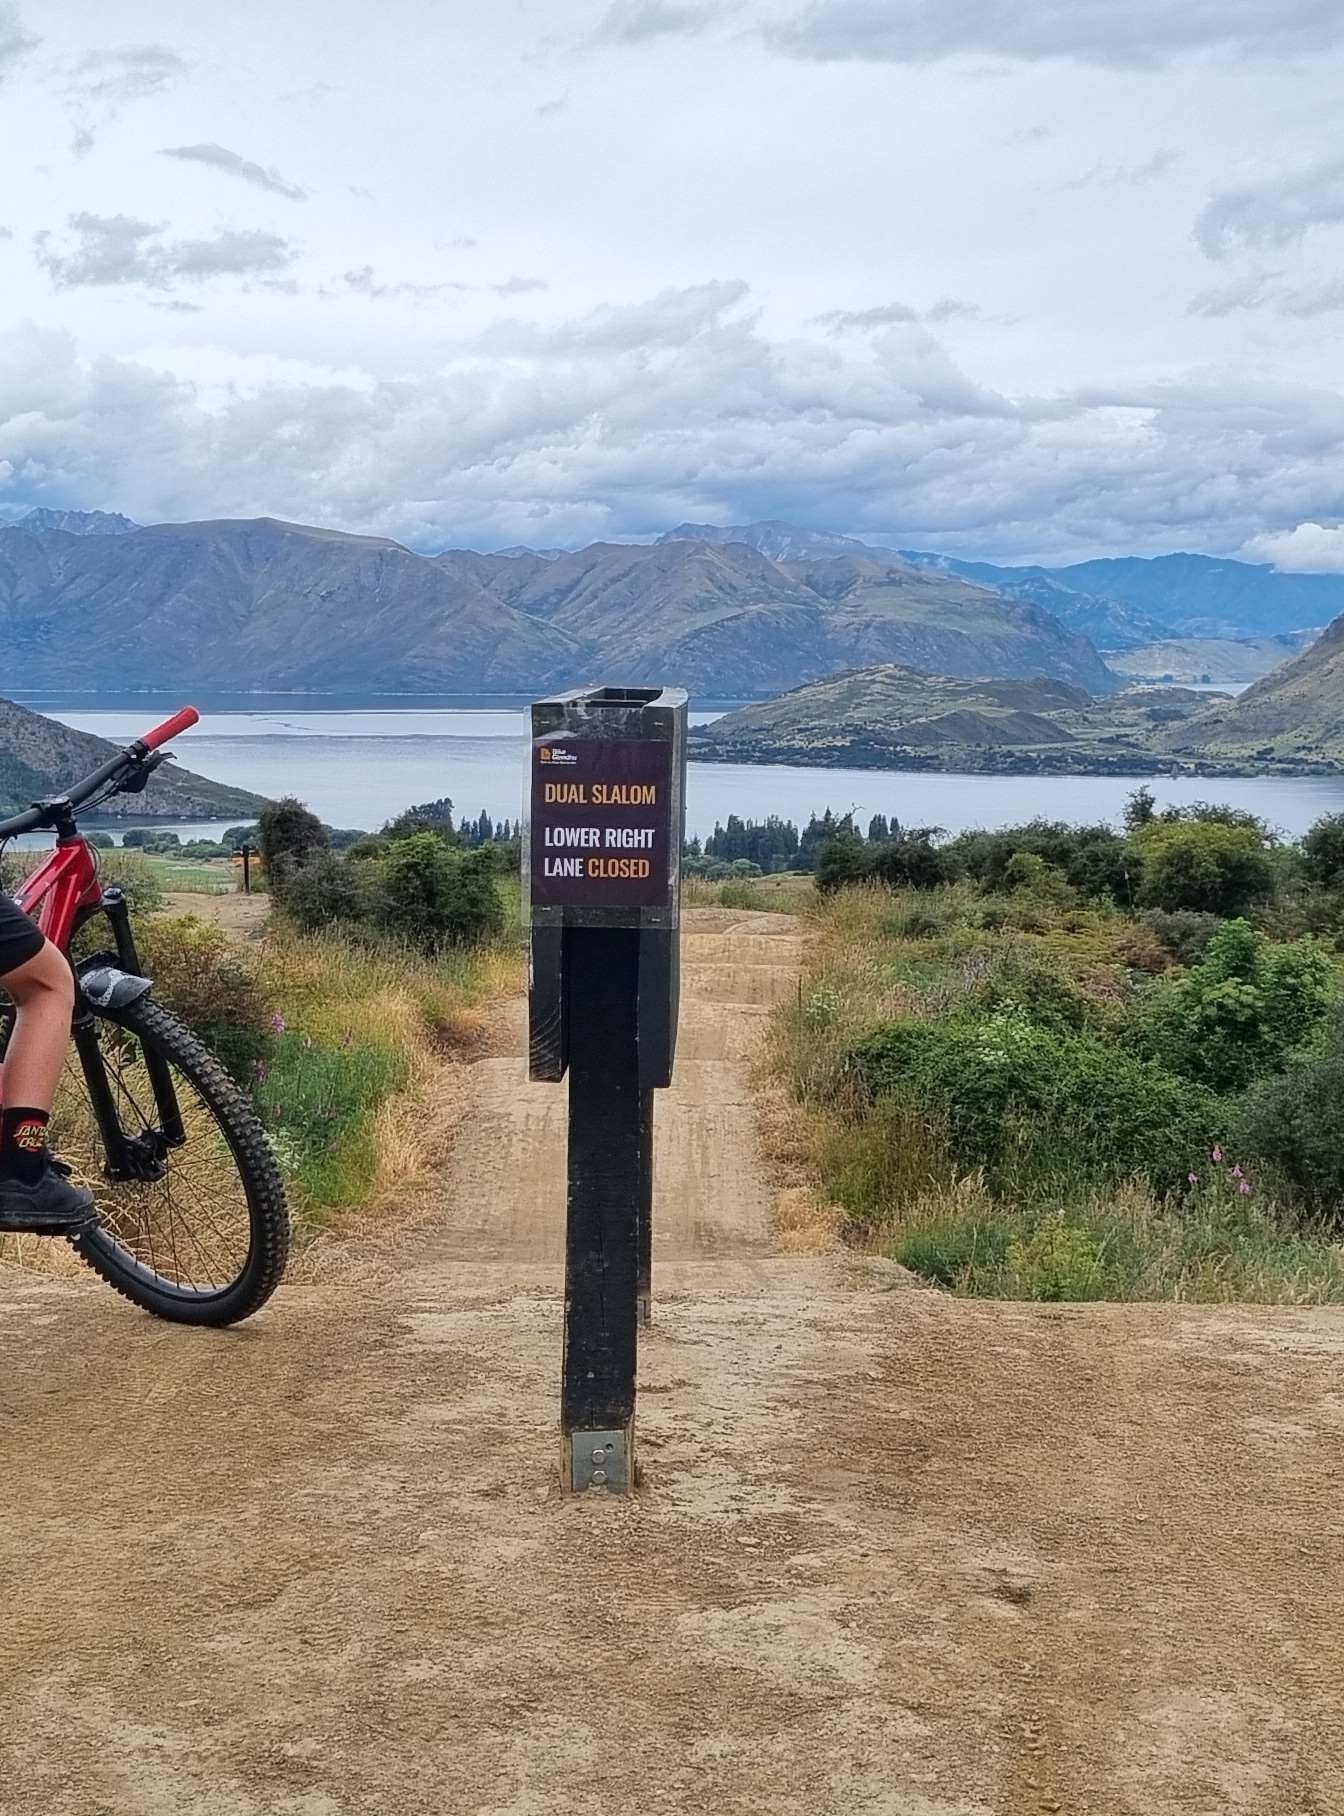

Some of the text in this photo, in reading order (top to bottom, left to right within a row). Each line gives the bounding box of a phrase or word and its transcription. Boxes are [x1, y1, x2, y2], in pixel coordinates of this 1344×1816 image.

[545, 783, 656, 805] DUAL SLALOM
[544, 826, 656, 849] LOWER RIGHT
[544, 857, 650, 878] LANE CLOSED
